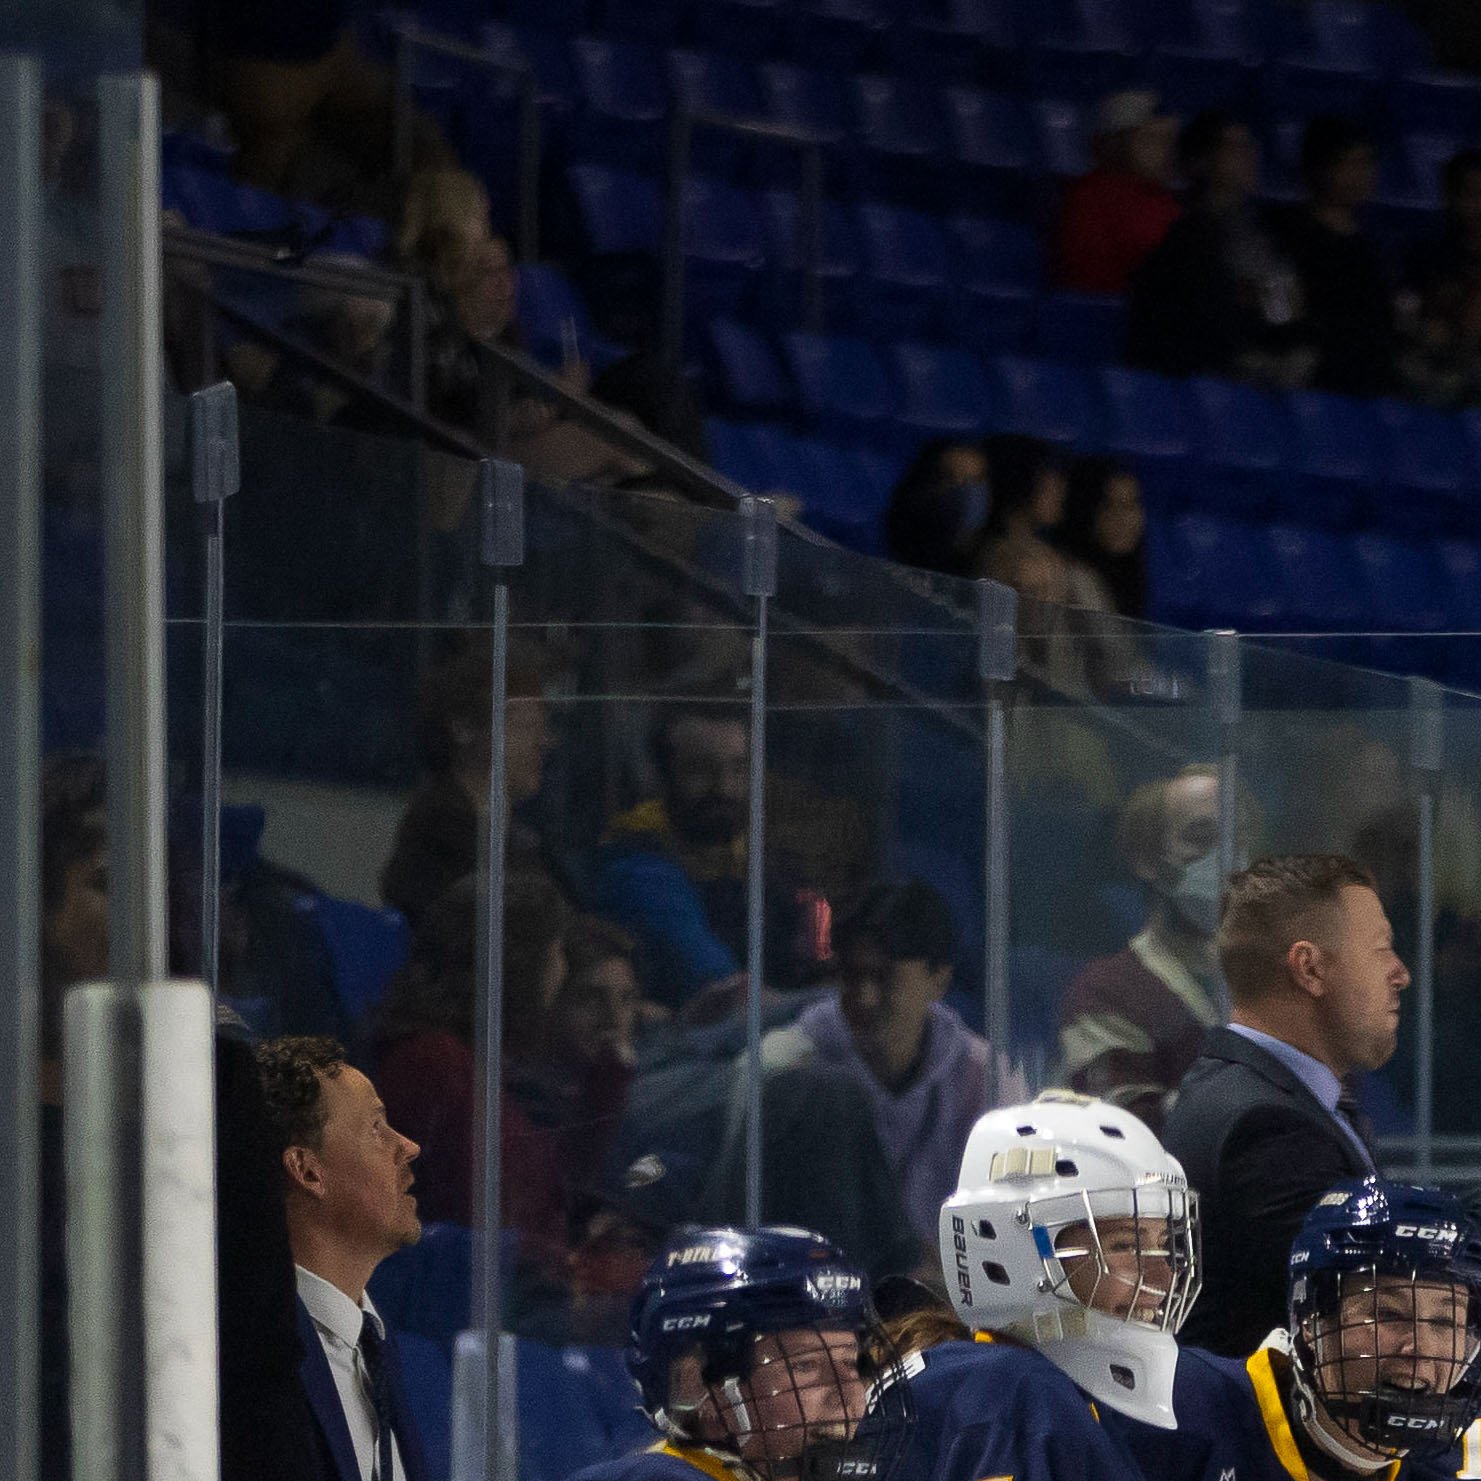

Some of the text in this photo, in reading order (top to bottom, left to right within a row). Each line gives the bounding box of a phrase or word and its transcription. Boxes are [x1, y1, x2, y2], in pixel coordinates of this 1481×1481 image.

[1394, 1224, 1459, 1243] CCM
[662, 1313, 711, 1332] CCM
[1386, 1414, 1446, 1431] CCM
